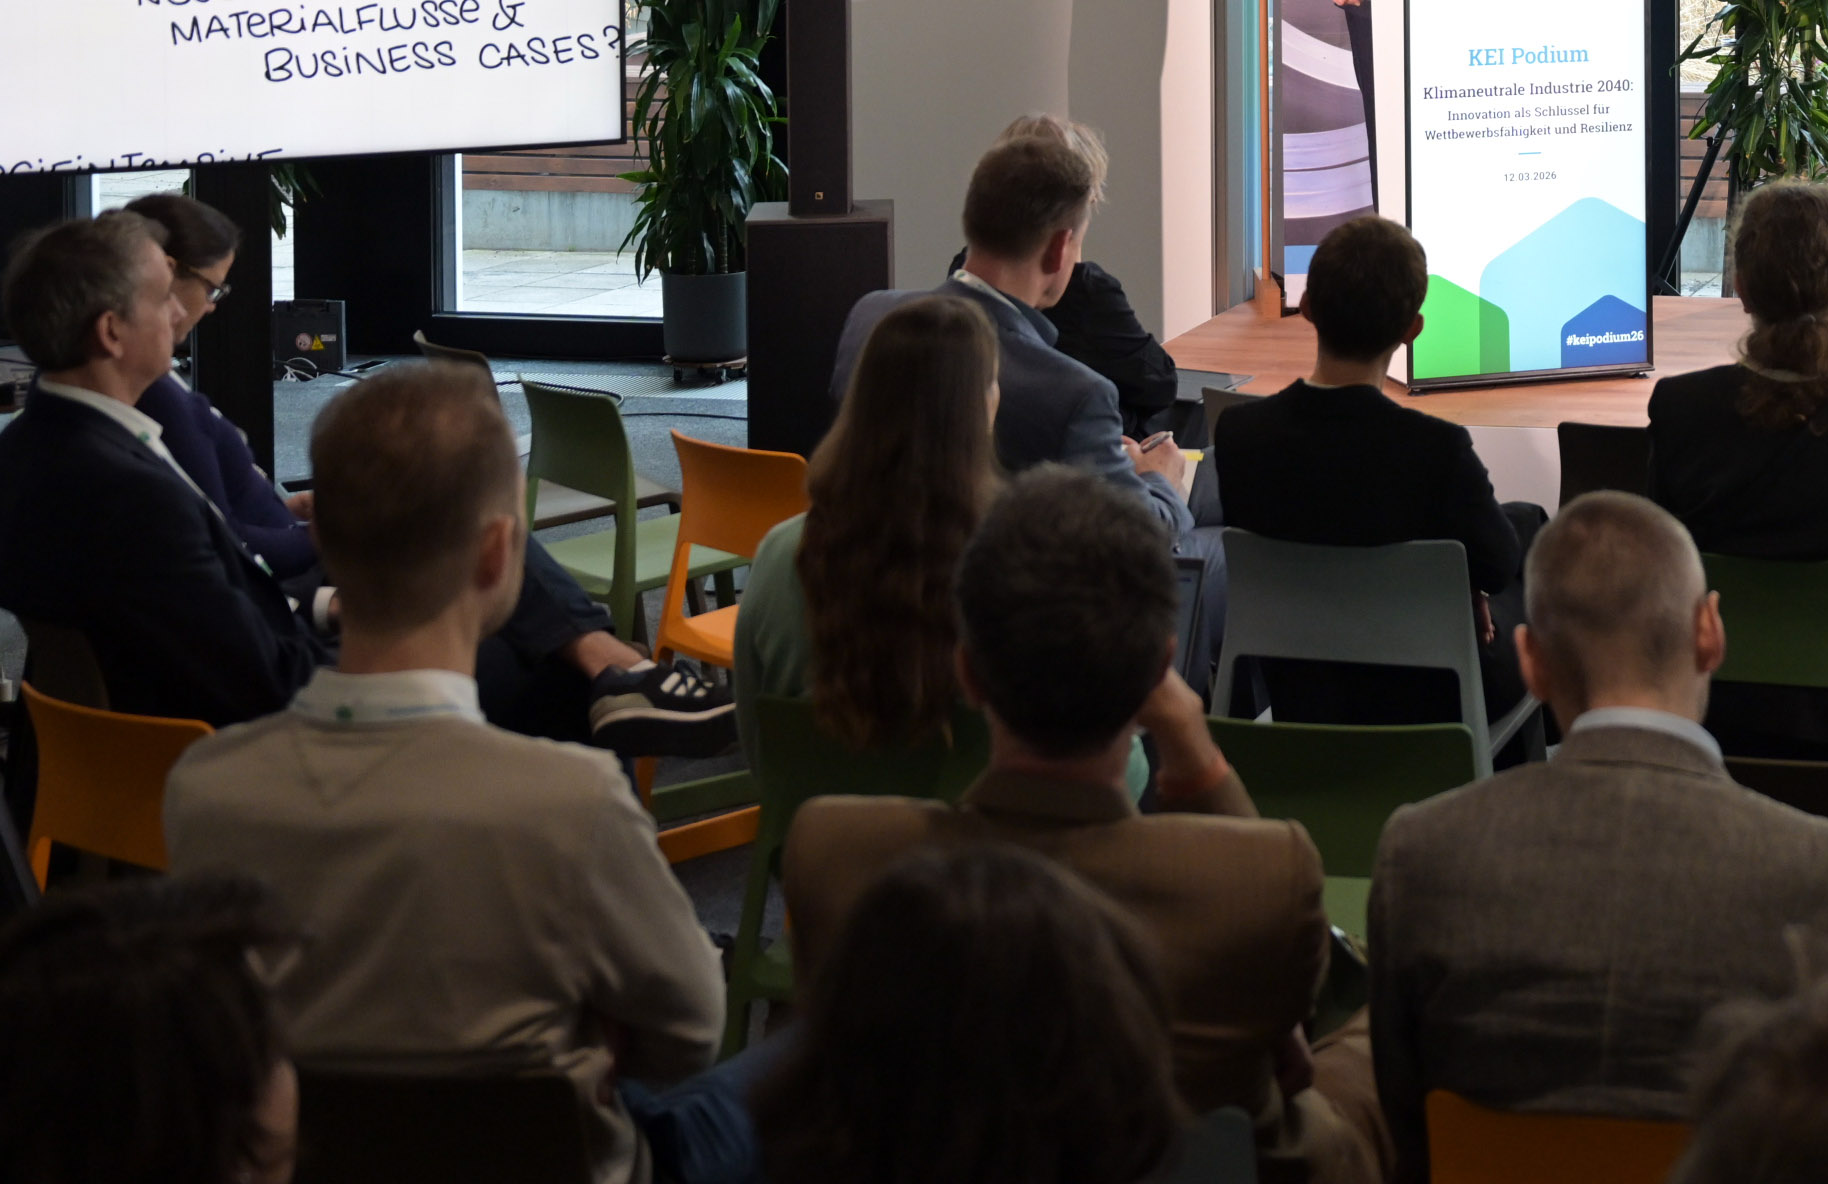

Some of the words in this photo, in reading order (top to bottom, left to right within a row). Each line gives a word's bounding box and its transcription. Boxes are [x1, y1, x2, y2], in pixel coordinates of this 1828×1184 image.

[1468, 47, 1505, 67] KEI
[1511, 44, 1590, 65] Podium
[1423, 82, 1526, 100] Klimaneutrale
[1529, 79, 1593, 96] Industrie
[1597, 78, 1634, 93] 2040:
[1447, 109, 1511, 121] Innovation
[1514, 106, 1532, 119] als
[1534, 103, 1590, 118] Schlüssel
[1593, 103, 1611, 115] für
[1424, 124, 1551, 141] Wettbewerbsfähigkeit
[1554, 122, 1577, 135] und
[1580, 121, 1633, 134] Resilienz
[1503, 170, 1557, 182] 12.03.2026
[1566, 330, 1644, 347] #keipodium26
